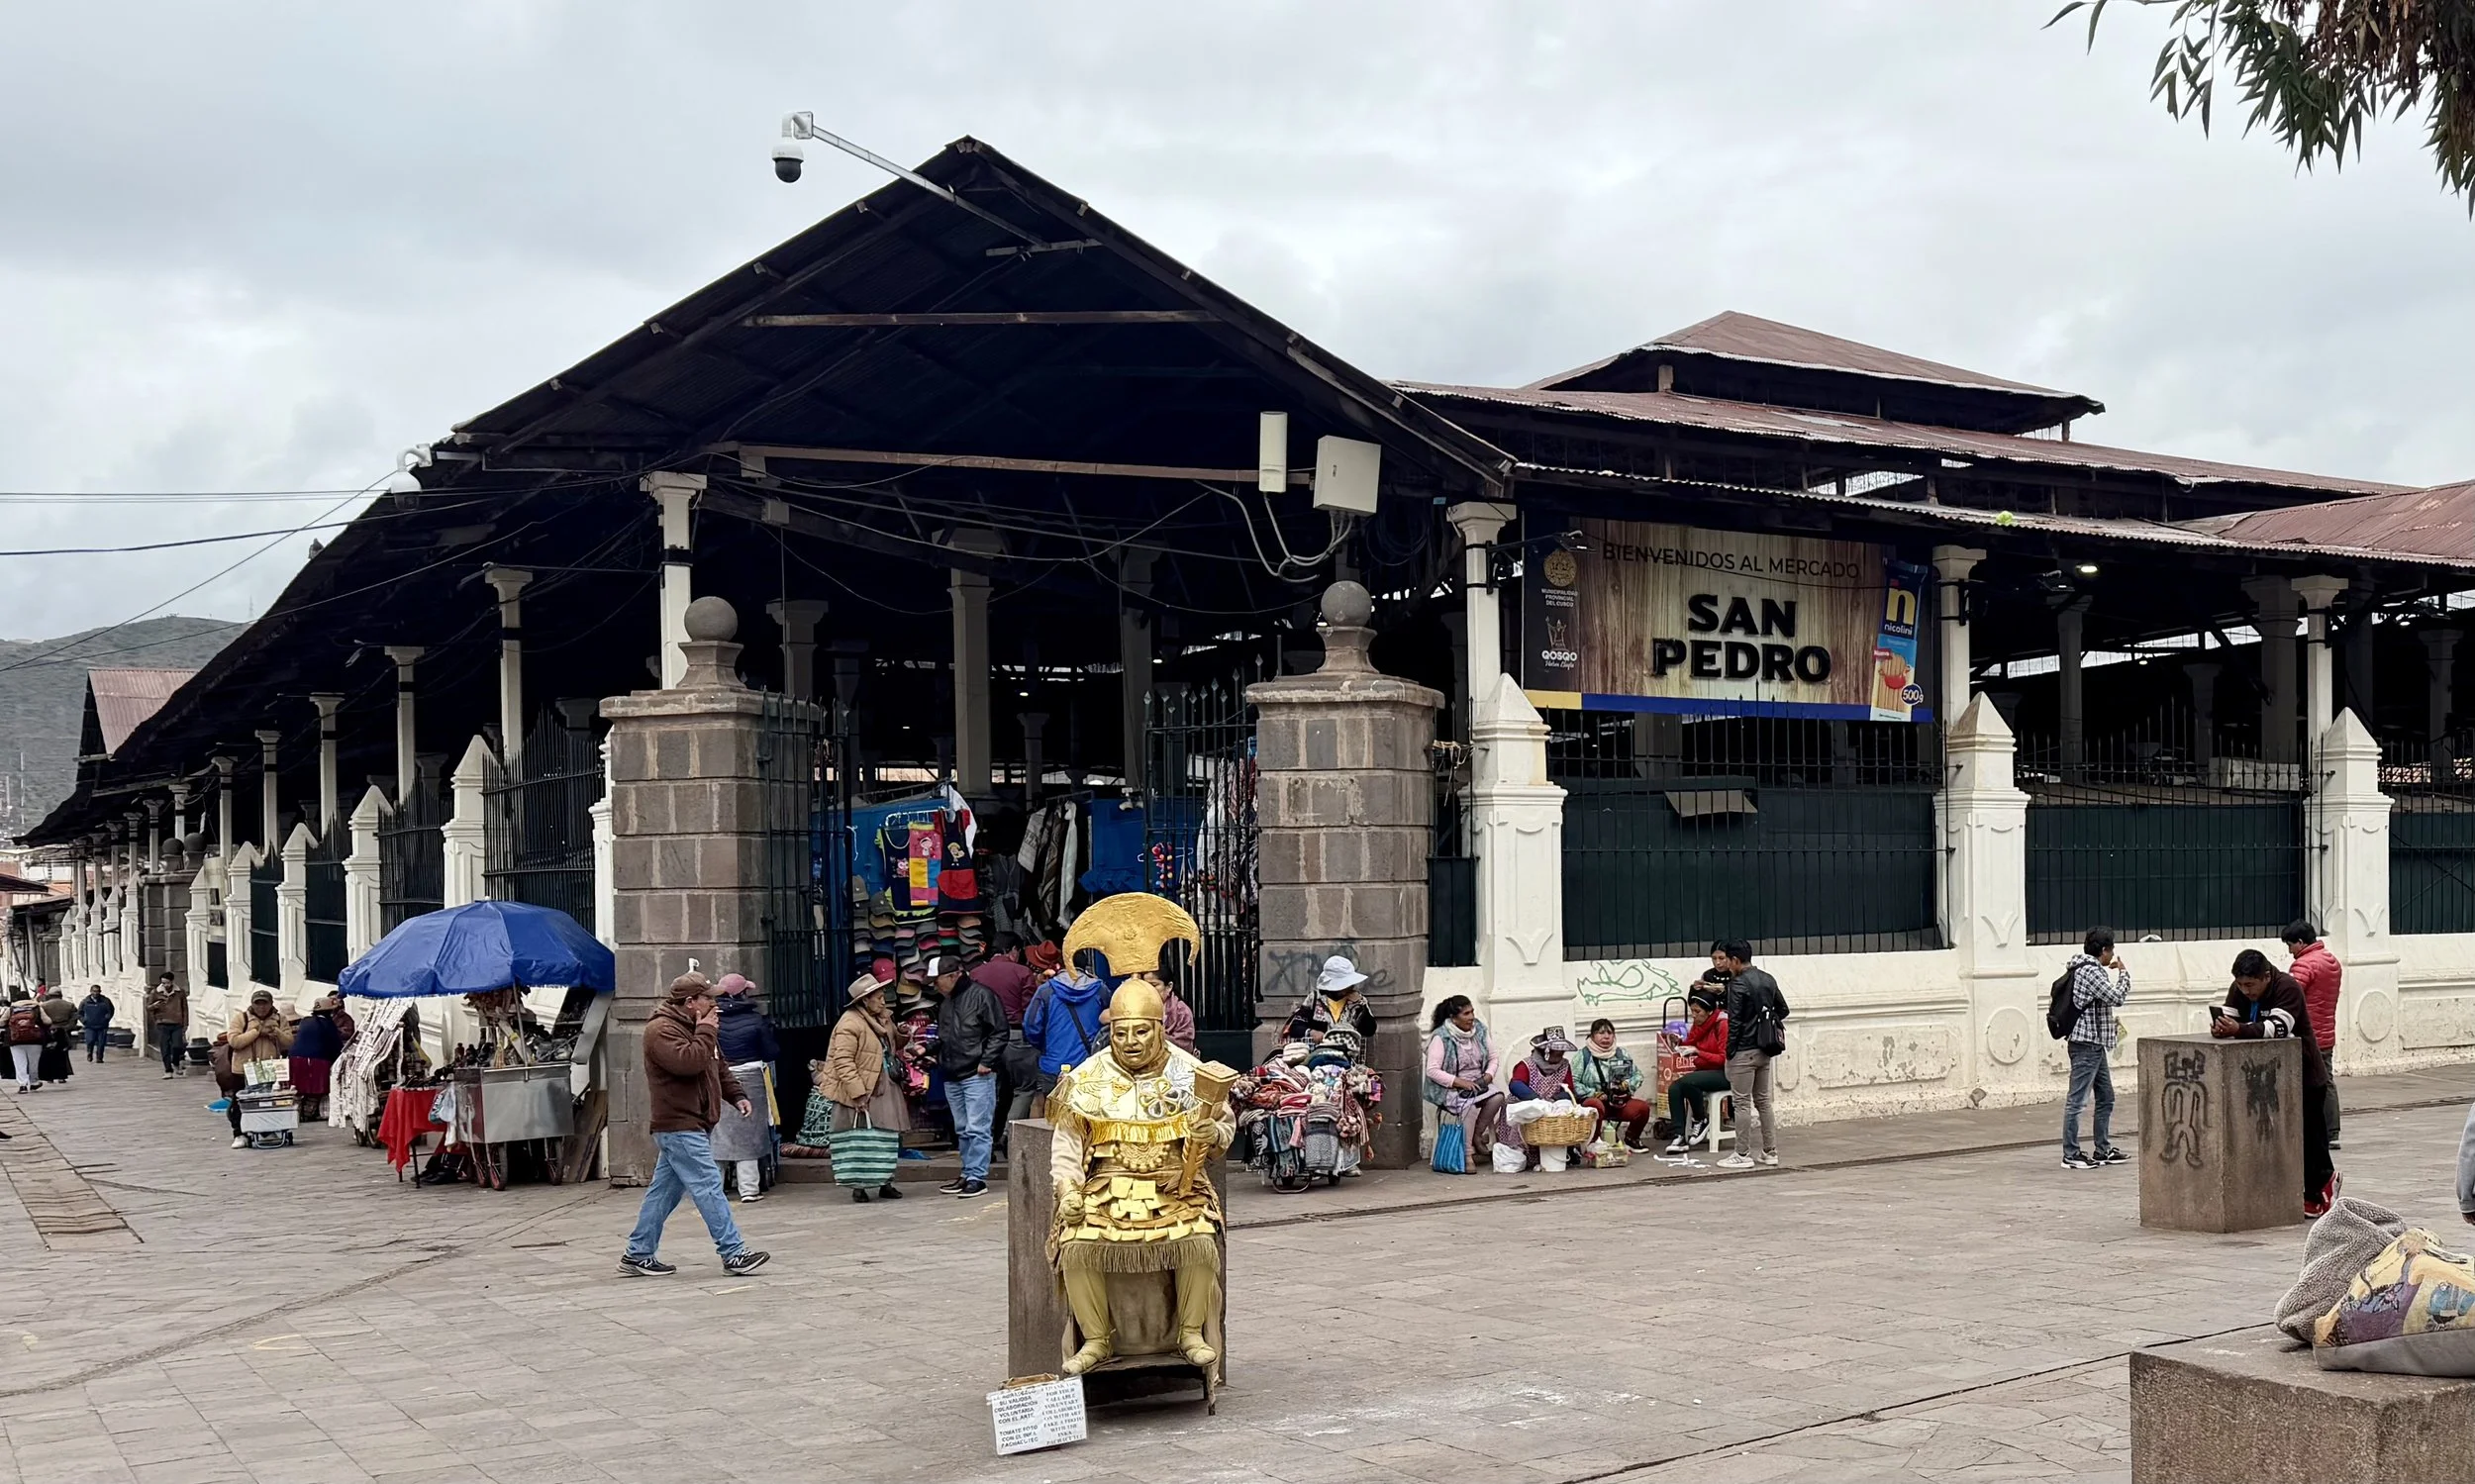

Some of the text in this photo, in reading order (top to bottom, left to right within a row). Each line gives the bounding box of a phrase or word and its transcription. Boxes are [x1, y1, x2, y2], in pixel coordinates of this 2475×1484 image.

[1603, 544, 1859, 579] BIENVENIDOS AL MERCADO
[1688, 594, 1796, 638] SAN
[1884, 623, 1913, 635] nicolini
[1541, 650, 1577, 661] QOSQO
[1651, 638, 1832, 682] PEDRO
[1903, 690, 1924, 703] 500g
